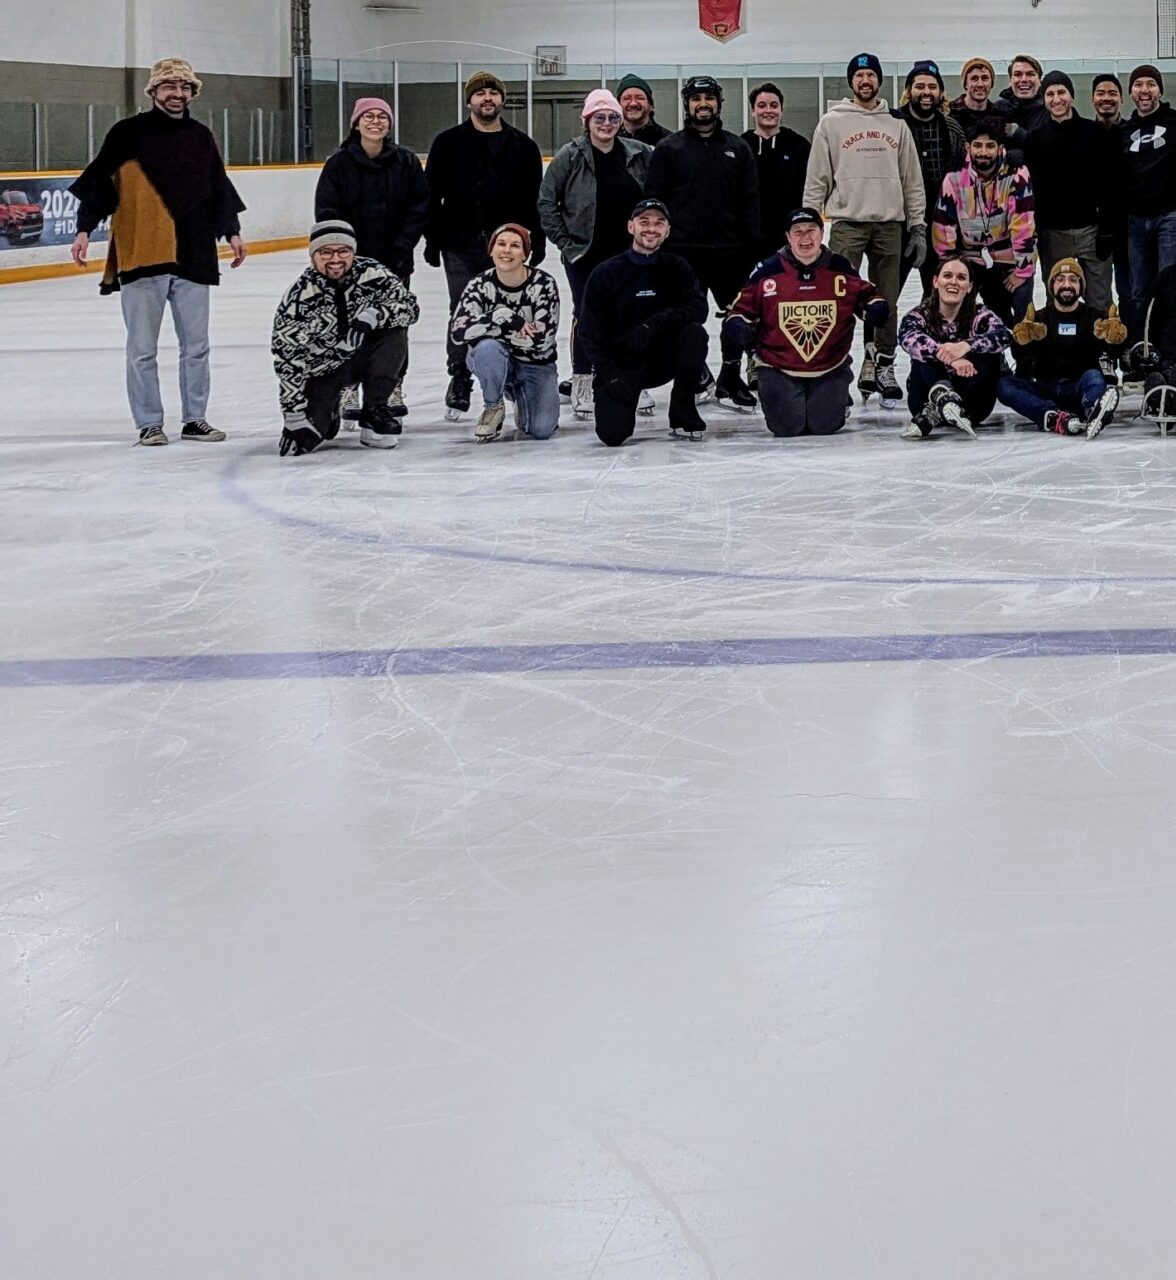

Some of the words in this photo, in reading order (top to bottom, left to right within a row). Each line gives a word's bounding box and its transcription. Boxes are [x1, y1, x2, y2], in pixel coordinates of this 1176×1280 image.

[842, 132, 865, 150] TRACK
[866, 131, 881, 139] AND
[881, 132, 898, 150] FIELD
[834, 275, 847, 297] C
[782, 304, 835, 323] VICTOIRE
